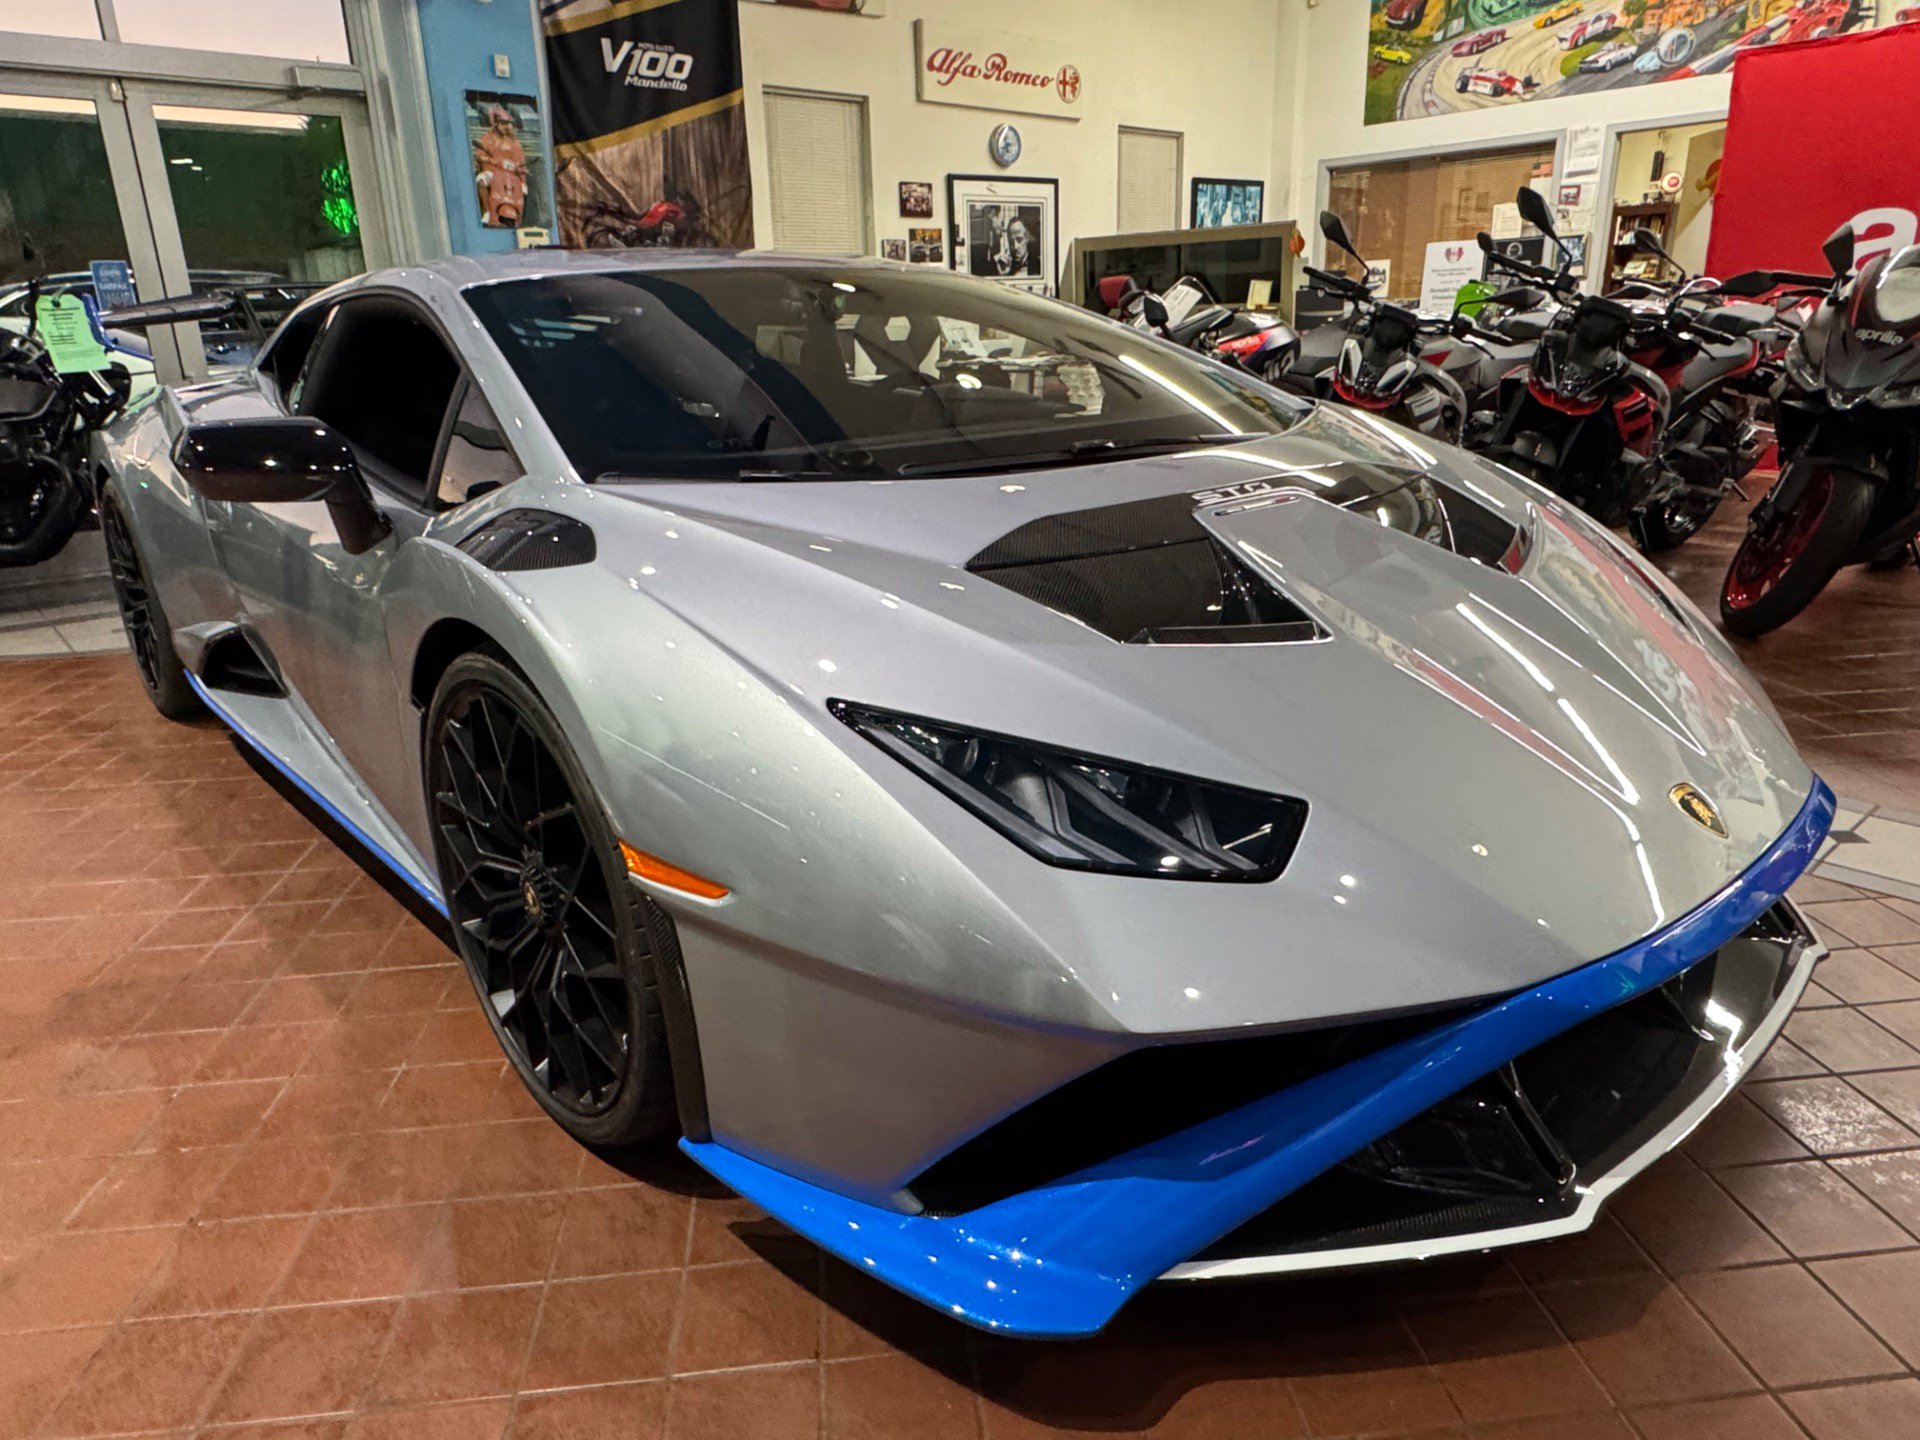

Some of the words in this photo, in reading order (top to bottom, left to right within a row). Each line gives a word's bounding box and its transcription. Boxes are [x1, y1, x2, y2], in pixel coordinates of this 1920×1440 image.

[601, 37, 693, 80] V100
[926, 48, 981, 86] Alfa
[983, 53, 1054, 88] Romeo
[624, 75, 687, 91] Mandello
[1855, 328, 1904, 346] aprilia
